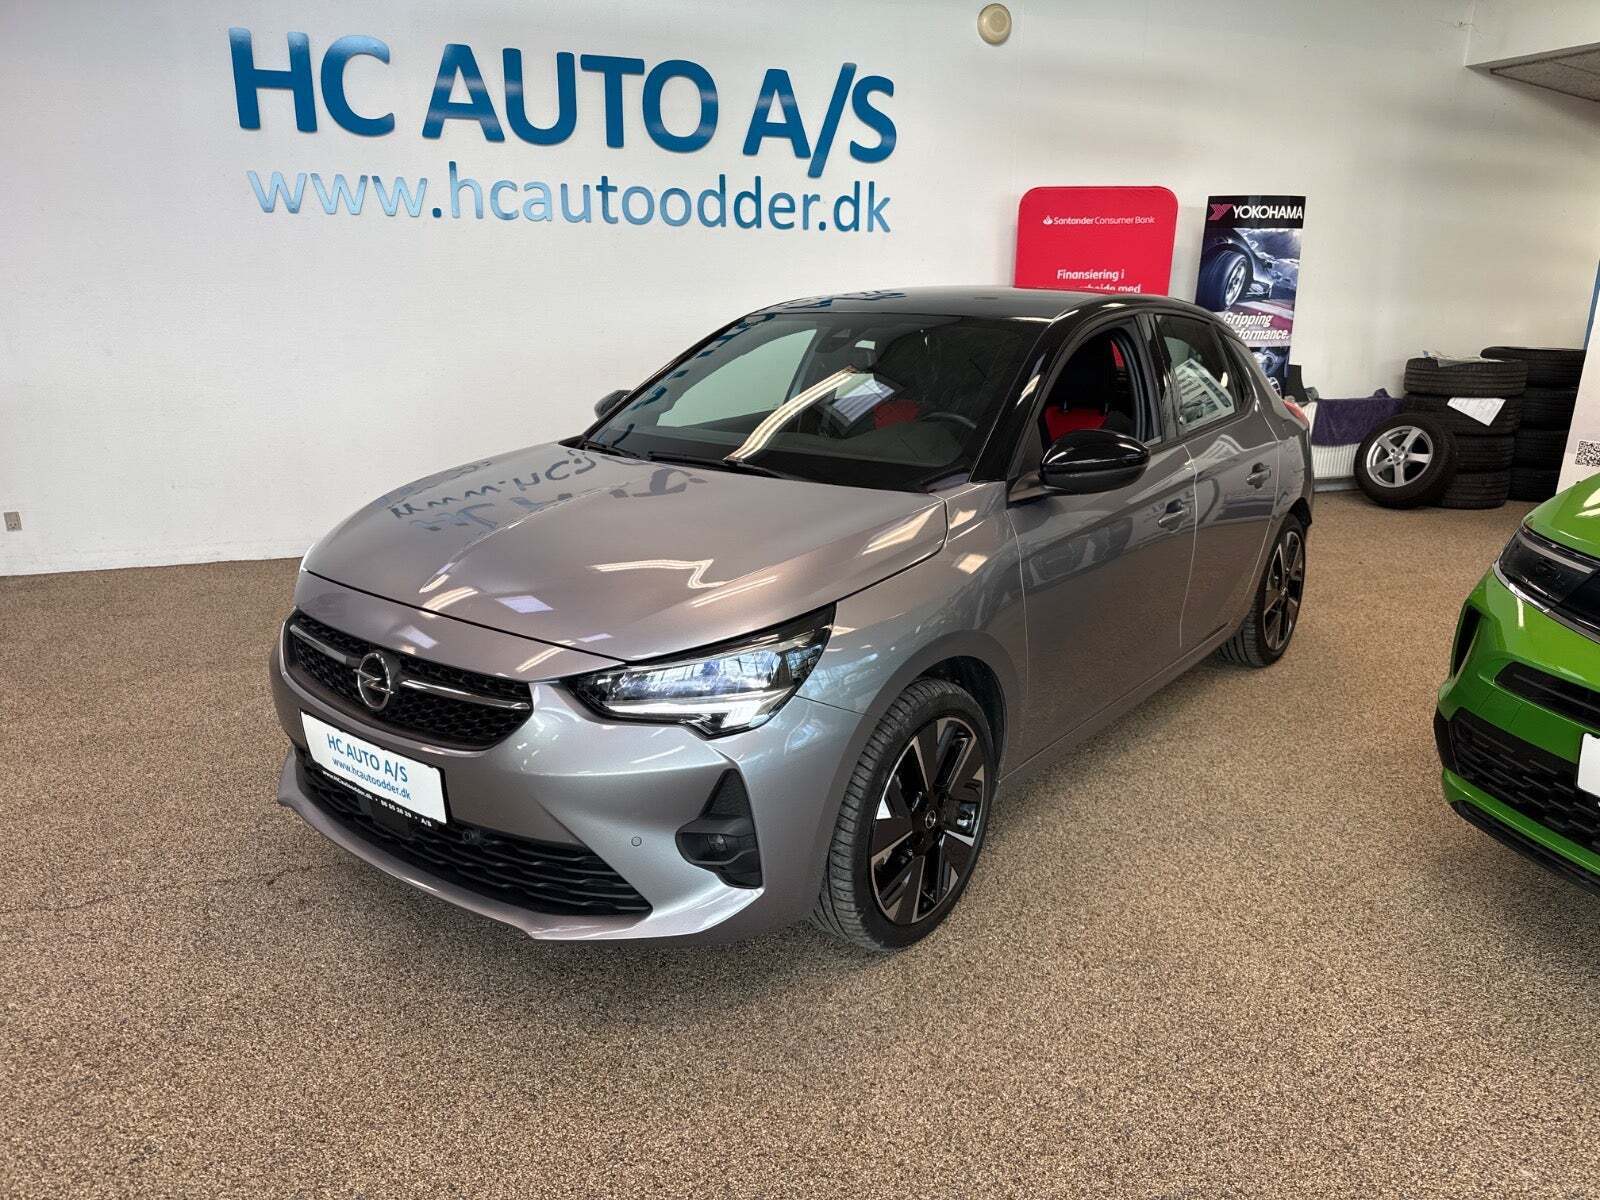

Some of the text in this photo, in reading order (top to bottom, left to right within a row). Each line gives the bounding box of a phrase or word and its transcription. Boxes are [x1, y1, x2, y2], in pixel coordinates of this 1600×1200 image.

[229, 27, 897, 179] HC AUTO A/S
[247, 160, 891, 233] www.hcautoodder.dk
[1053, 215, 1156, 225] Santander Consumer Bank
[1232, 204, 1304, 220] YOKOHAMA
[1056, 268, 1125, 282] Finansiering i
[1223, 311, 1274, 328] Gripping
[1233, 327, 1291, 341] formance.
[327, 733, 409, 783] HC AUTO A/S
[332, 757, 412, 801] www.hcautoodder.dk
